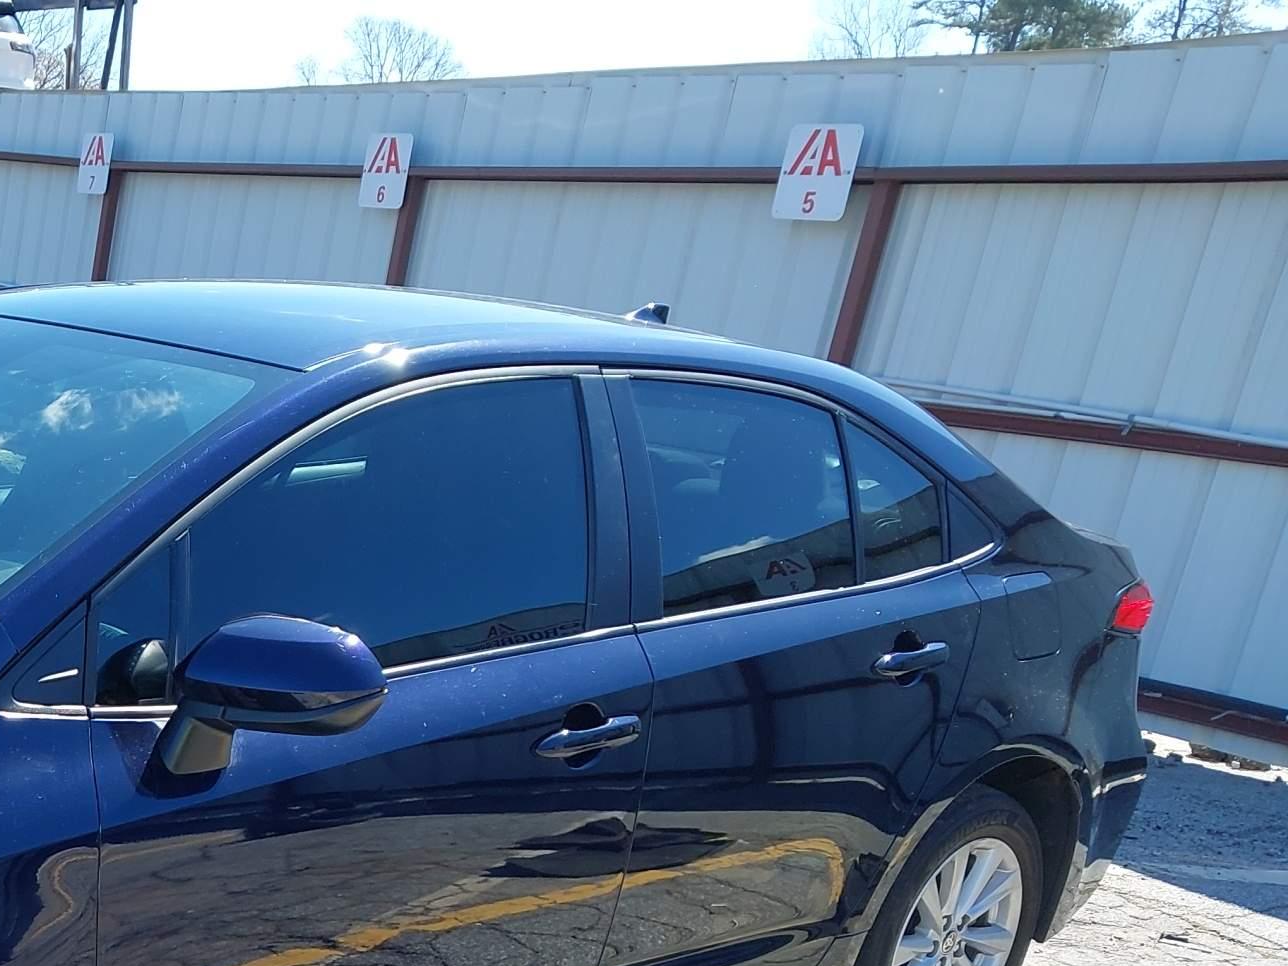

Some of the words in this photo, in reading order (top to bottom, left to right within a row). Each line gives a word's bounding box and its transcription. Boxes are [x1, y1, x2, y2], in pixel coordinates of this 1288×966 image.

[89, 175, 95, 190] 7
[376, 185, 386, 203] 6
[802, 191, 816, 213] 5
